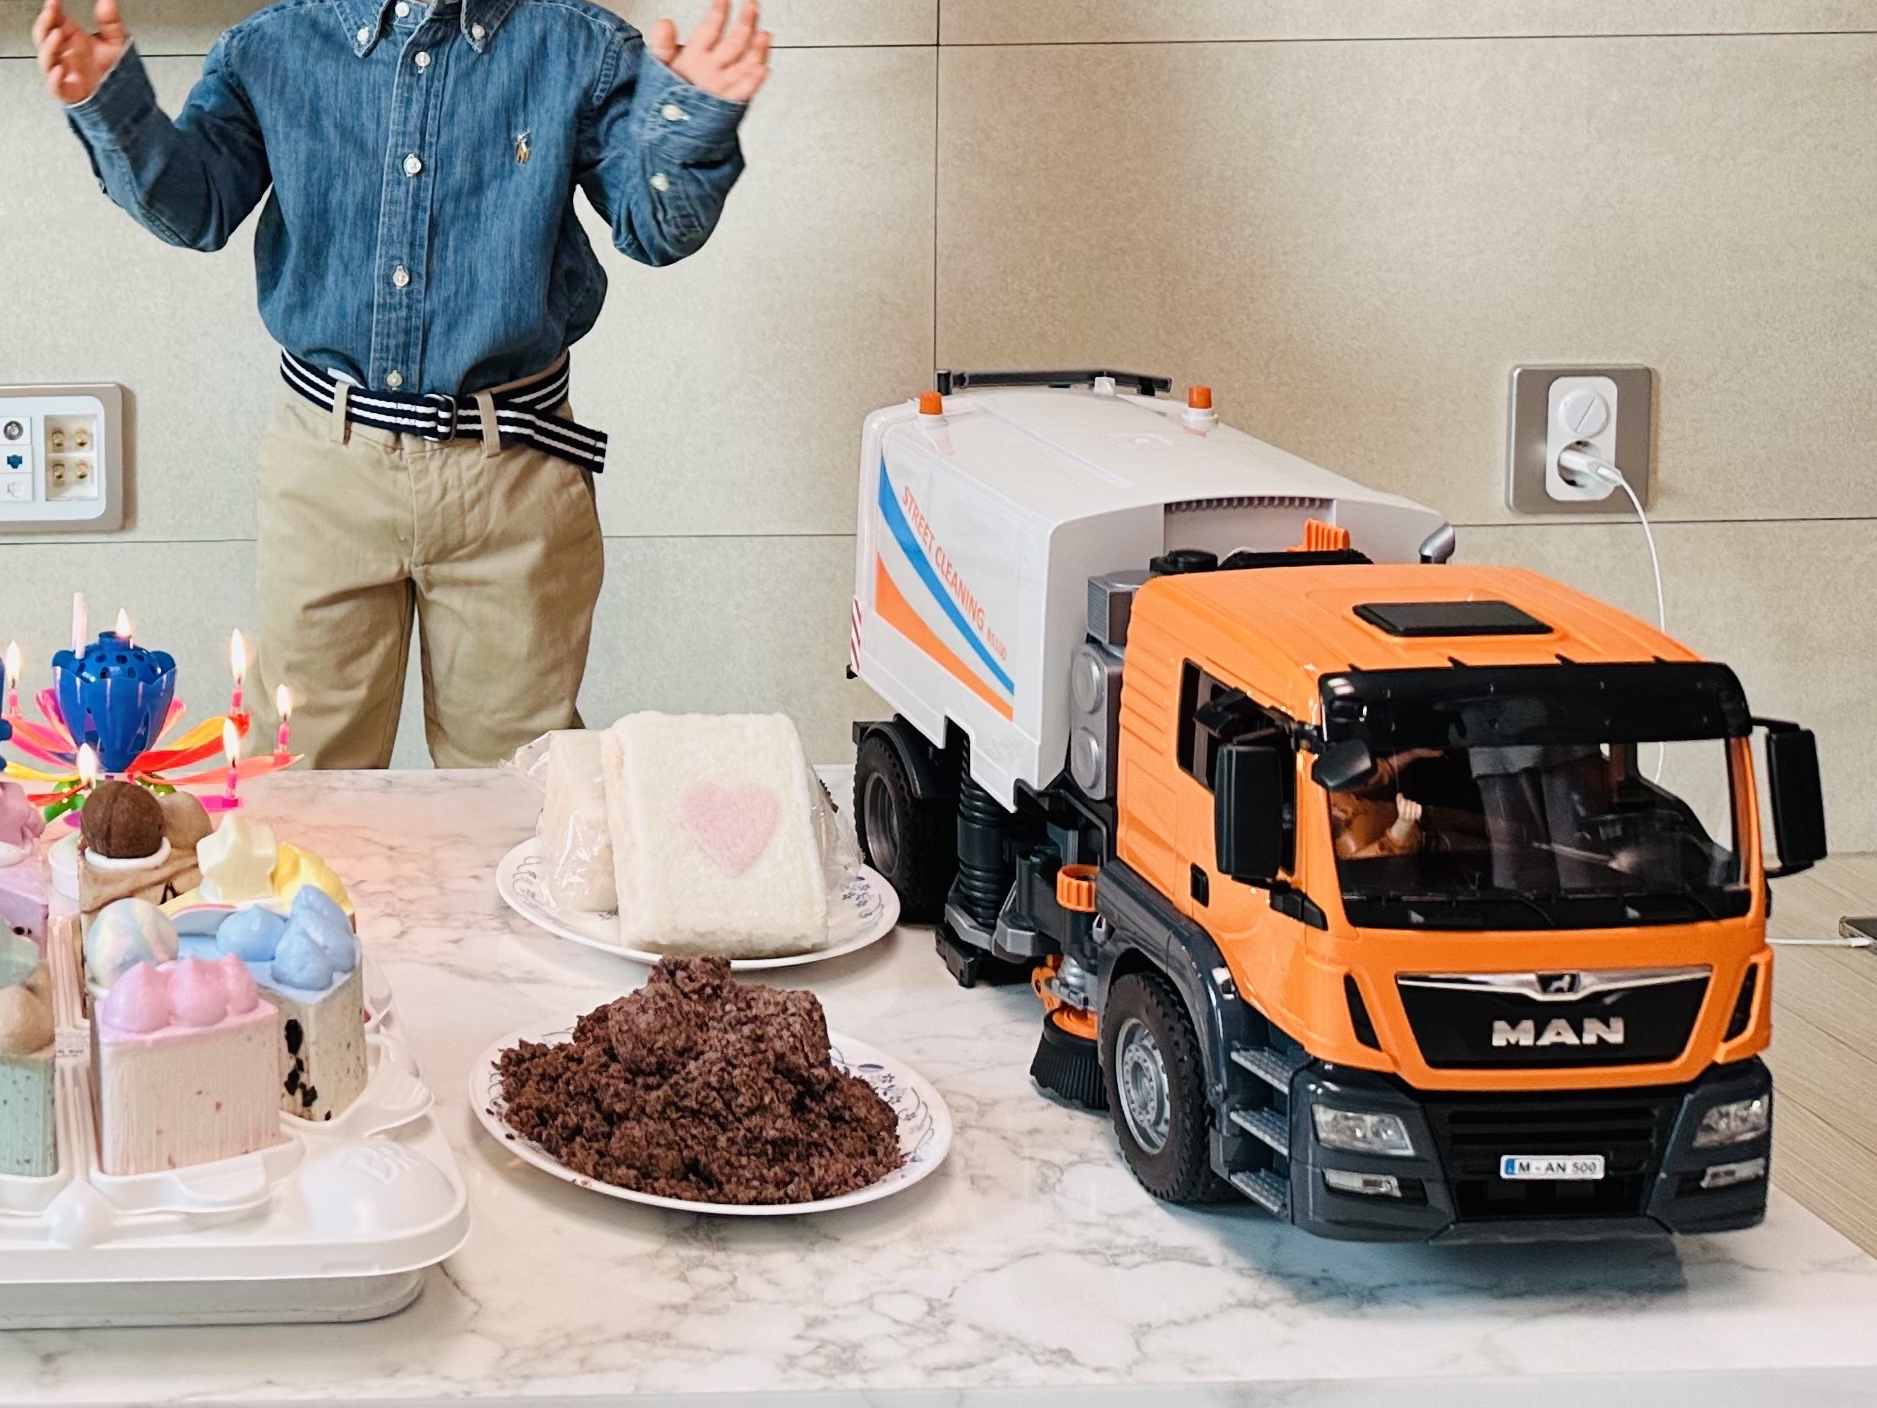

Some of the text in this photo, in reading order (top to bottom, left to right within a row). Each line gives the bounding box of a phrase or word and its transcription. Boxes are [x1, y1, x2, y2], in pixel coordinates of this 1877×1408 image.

[902, 485, 936, 552] STREET
[934, 545, 986, 631] CLEANING
[1491, 1016, 1625, 1047] MAN
[1518, 1161, 1531, 1173] M
[1544, 1161, 1567, 1174] AN
[1572, 1161, 1597, 1175] 500
